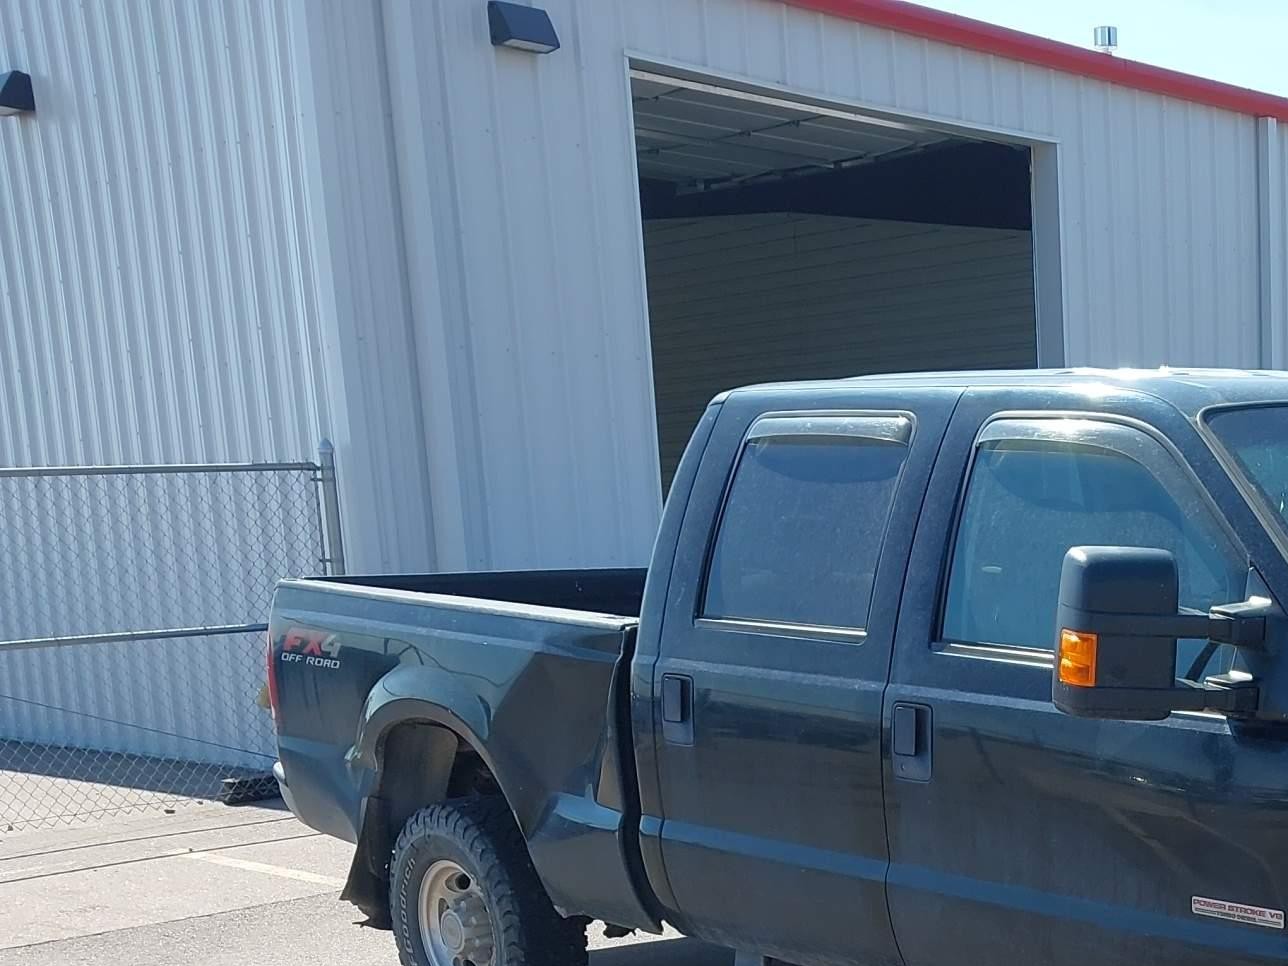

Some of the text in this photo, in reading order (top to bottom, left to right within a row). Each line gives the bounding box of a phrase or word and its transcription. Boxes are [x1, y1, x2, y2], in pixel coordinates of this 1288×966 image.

[283, 629, 341, 658] FX4
[281, 652, 340, 669] OFF ROAD
[1193, 899, 1227, 911] POWER
[1227, 905, 1266, 918] STROKE
